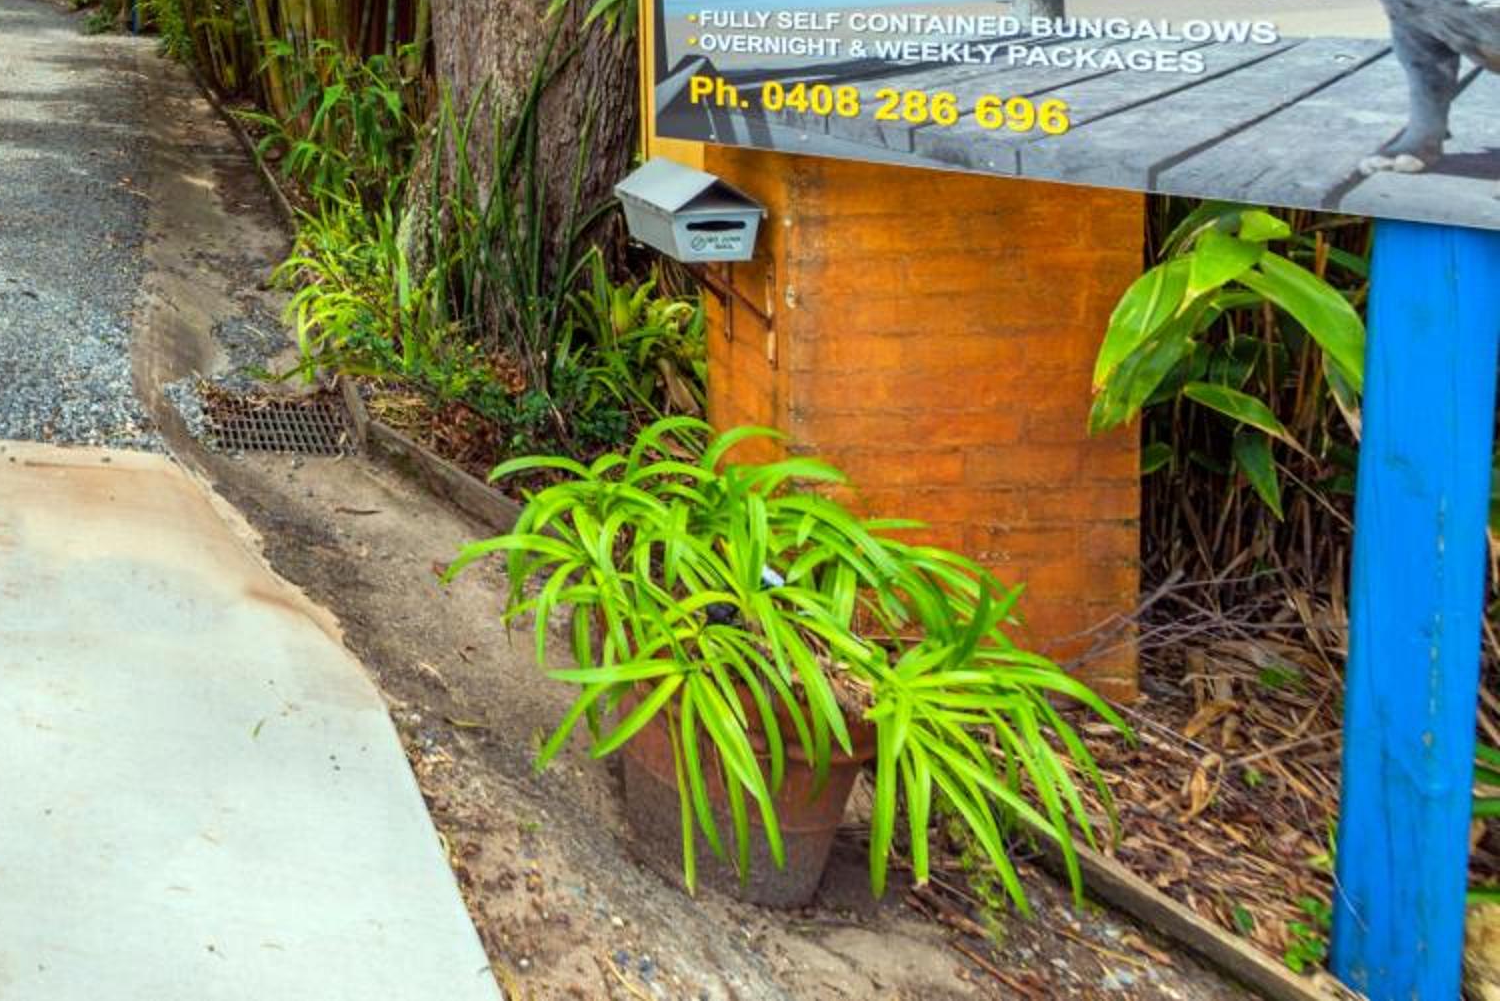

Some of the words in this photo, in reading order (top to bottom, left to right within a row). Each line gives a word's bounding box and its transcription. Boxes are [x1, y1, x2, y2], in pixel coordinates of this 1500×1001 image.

[701, 10, 771, 29] FULLY
[777, 11, 841, 32] SELF
[849, 12, 1020, 38] CONTAINED
[1030, 16, 1280, 45] BUNGALOWS
[700, 33, 841, 57] OVERNIGHT
[850, 38, 868, 59] &
[874, 40, 1000, 65] WEEKLY
[1007, 45, 1207, 74] PACKAGES
[690, 76, 749, 109] Ph.
[761, 80, 861, 118] 0408
[875, 88, 959, 126] 286
[974, 94, 1070, 136] 696
